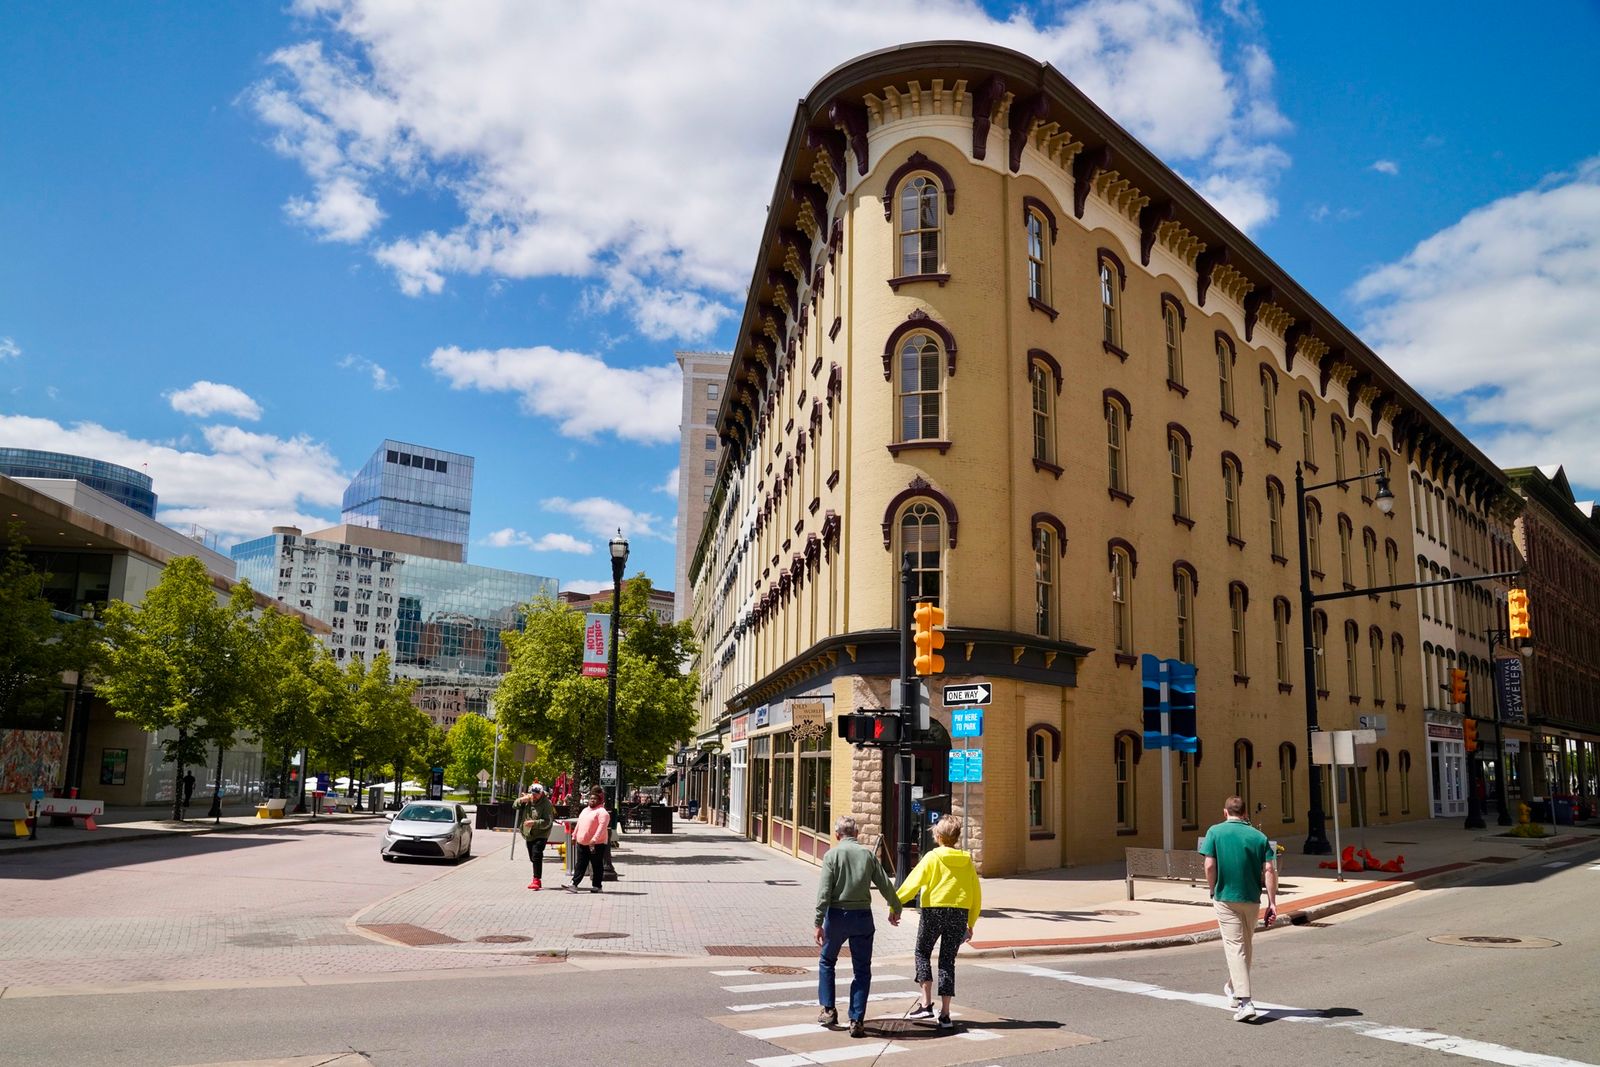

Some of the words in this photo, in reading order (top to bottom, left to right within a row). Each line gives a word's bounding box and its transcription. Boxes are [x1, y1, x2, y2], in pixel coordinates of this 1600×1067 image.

[587, 625, 595, 650] HOTEL
[595, 620, 604, 656] DISTRICT
[1511, 659, 1525, 718] JEWELERS
[948, 692, 963, 700] ONE
[964, 691, 979, 699] WAY
[954, 714, 964, 722] PAY
[964, 713, 978, 721] HERE
[955, 723, 963, 731] TO
[963, 723, 977, 731] PARK
[931, 812, 939, 823] P
